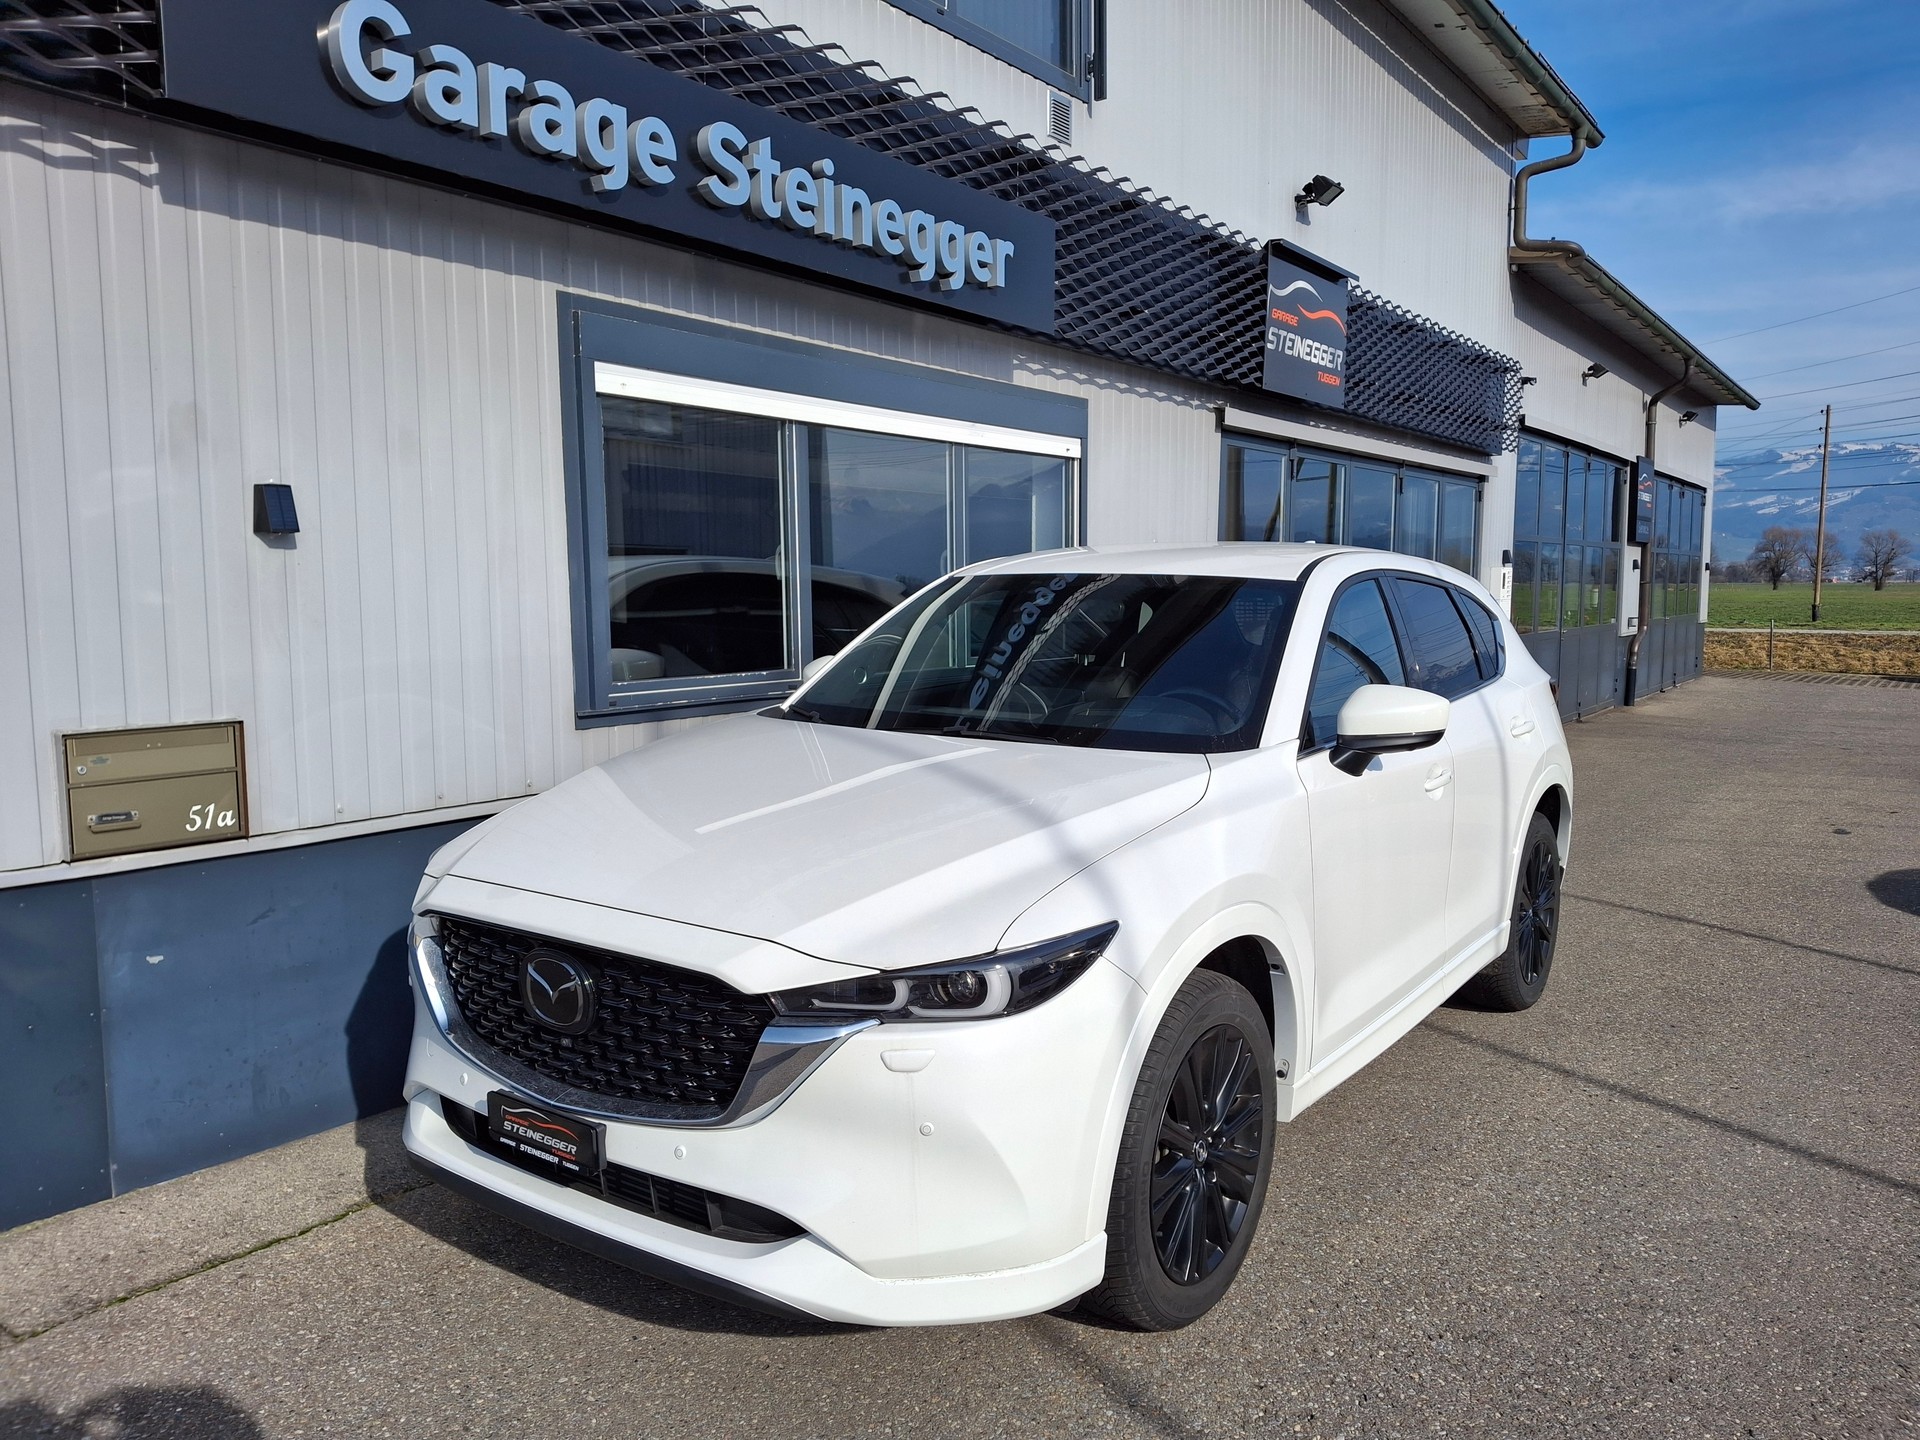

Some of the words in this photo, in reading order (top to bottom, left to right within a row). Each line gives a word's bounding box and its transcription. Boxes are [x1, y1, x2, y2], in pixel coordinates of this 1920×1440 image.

[318, 0, 678, 192] Garage
[698, 121, 1014, 291] Steinegger
[1271, 308, 1299, 326] GARAGE
[1266, 326, 1343, 371] STEINEGGER
[1317, 371, 1341, 386] TUGGEN
[185, 803, 236, 832] 51a
[503, 1120, 577, 1154] STEINEGGER
[520, 1143, 559, 1164] STEINEGGER
